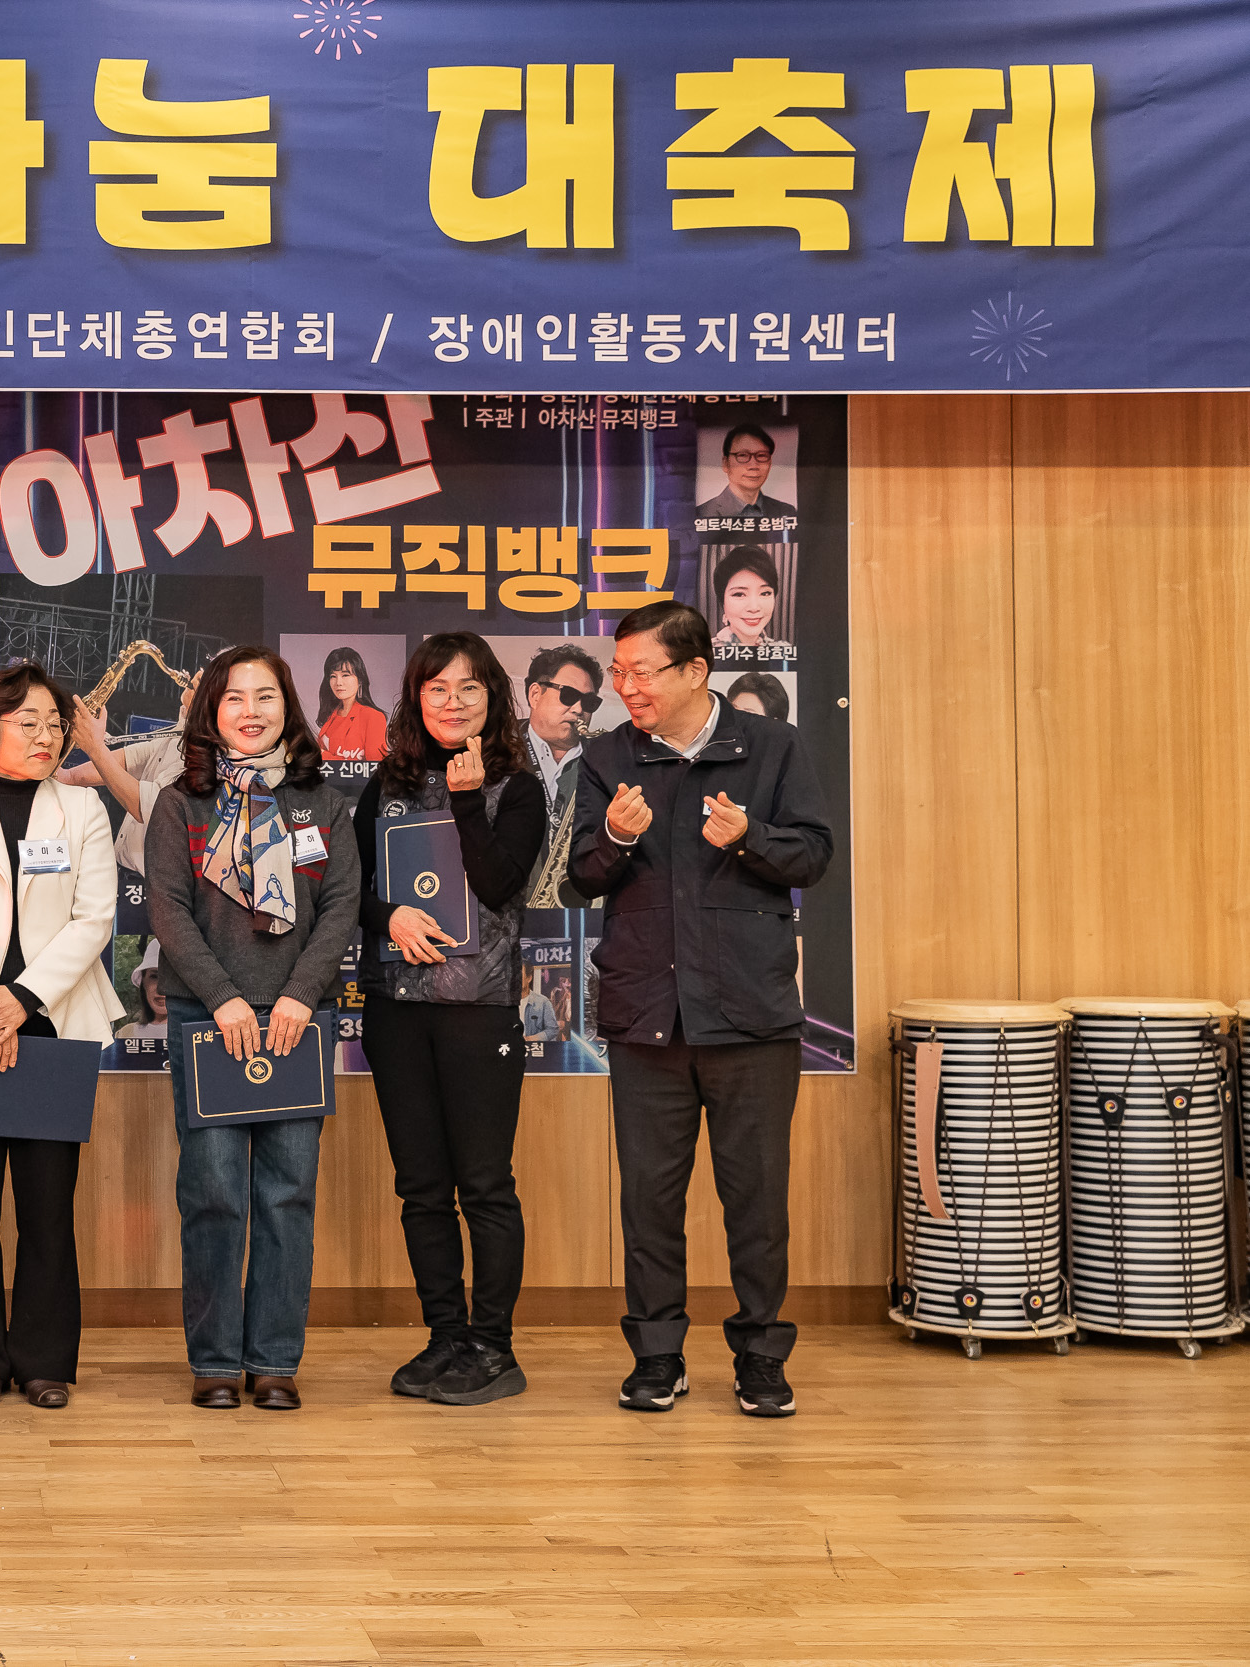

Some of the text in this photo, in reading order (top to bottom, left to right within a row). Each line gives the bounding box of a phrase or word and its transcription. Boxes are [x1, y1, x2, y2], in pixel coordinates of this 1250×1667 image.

[427, 57, 1096, 252] 대축제
[427, 311, 897, 363] 장애인활동지원센터
[475, 408, 678, 430] 주관 아차산 뮤직뱅크
[694, 516, 799, 532] 엘토색소폰 윤범규
[308, 524, 675, 613] 뮤직뱅크
[757, 646, 798, 661] 한효민
[317, 761, 335, 778] 수
[124, 885, 147, 905] 정
[124, 1038, 156, 1054] 엘토
